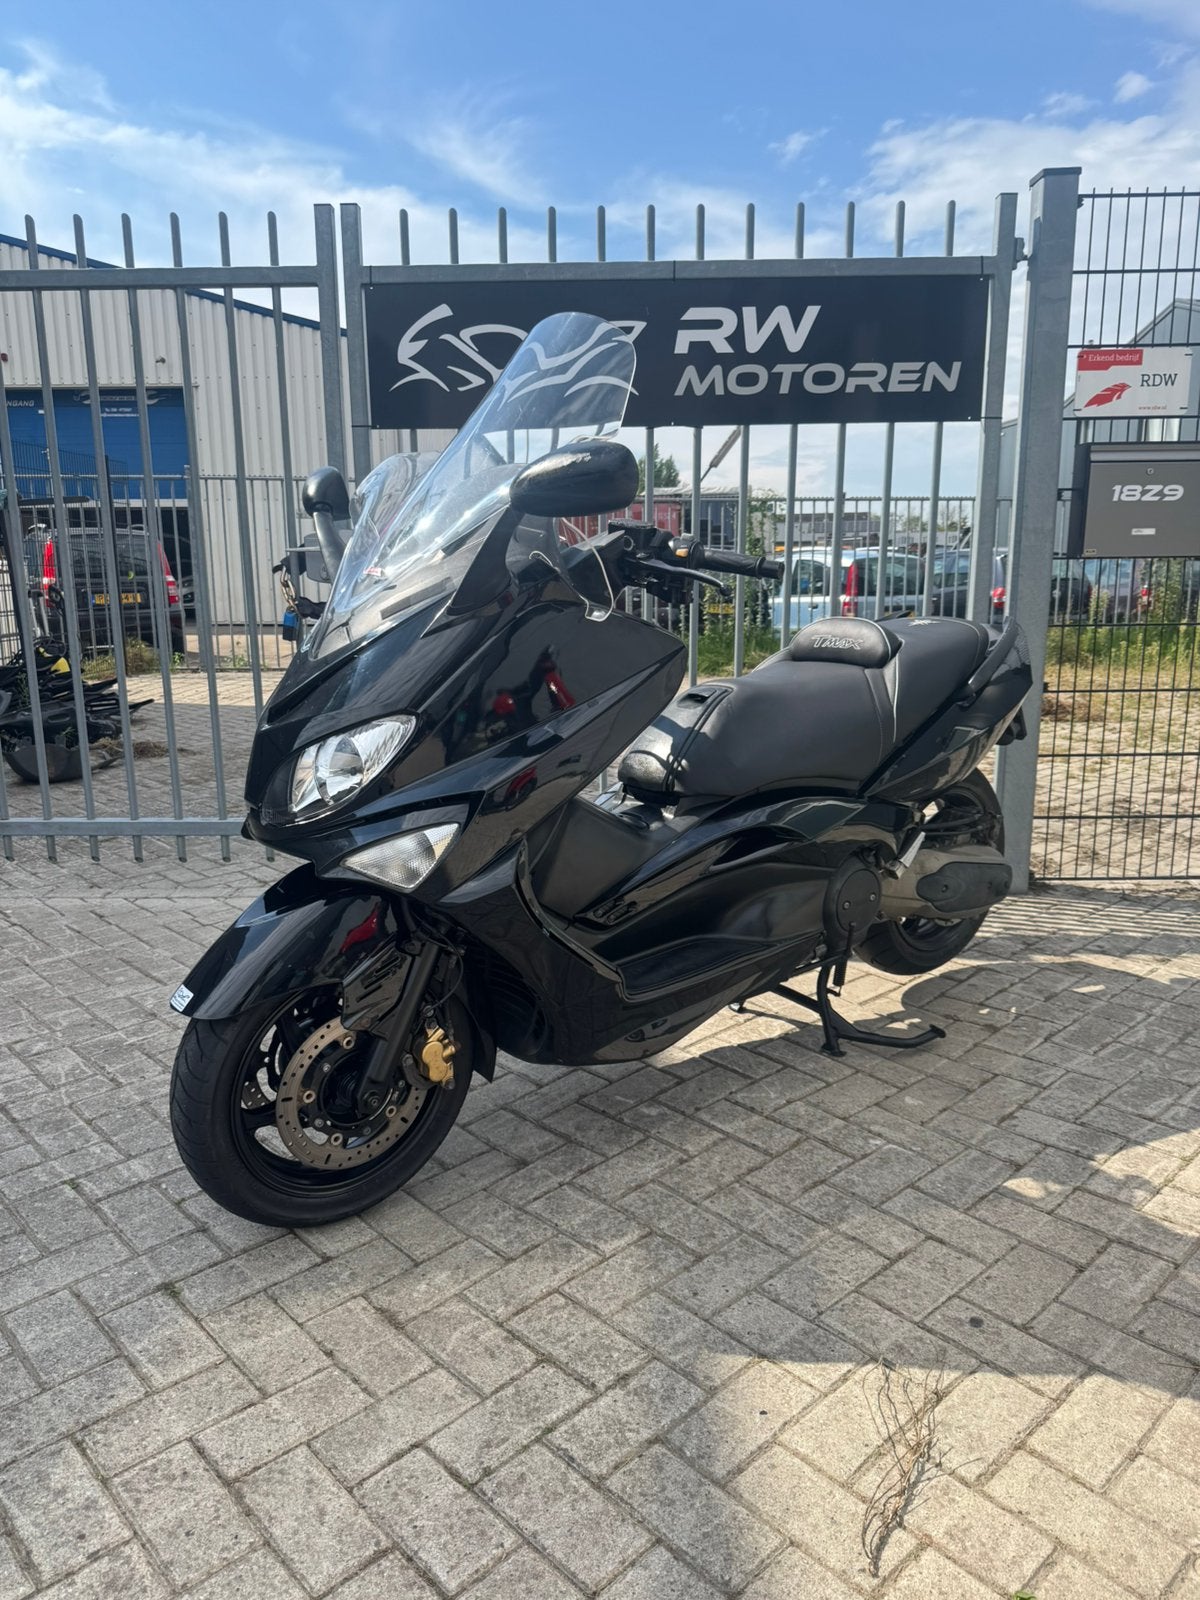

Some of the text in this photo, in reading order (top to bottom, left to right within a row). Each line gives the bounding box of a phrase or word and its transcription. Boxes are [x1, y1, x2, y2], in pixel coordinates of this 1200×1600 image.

[674, 305, 822, 354] RW
[1088, 353, 1140, 362] Erkend bedrijf
[674, 361, 962, 396] MOTOREN
[1140, 373, 1178, 387] RDW
